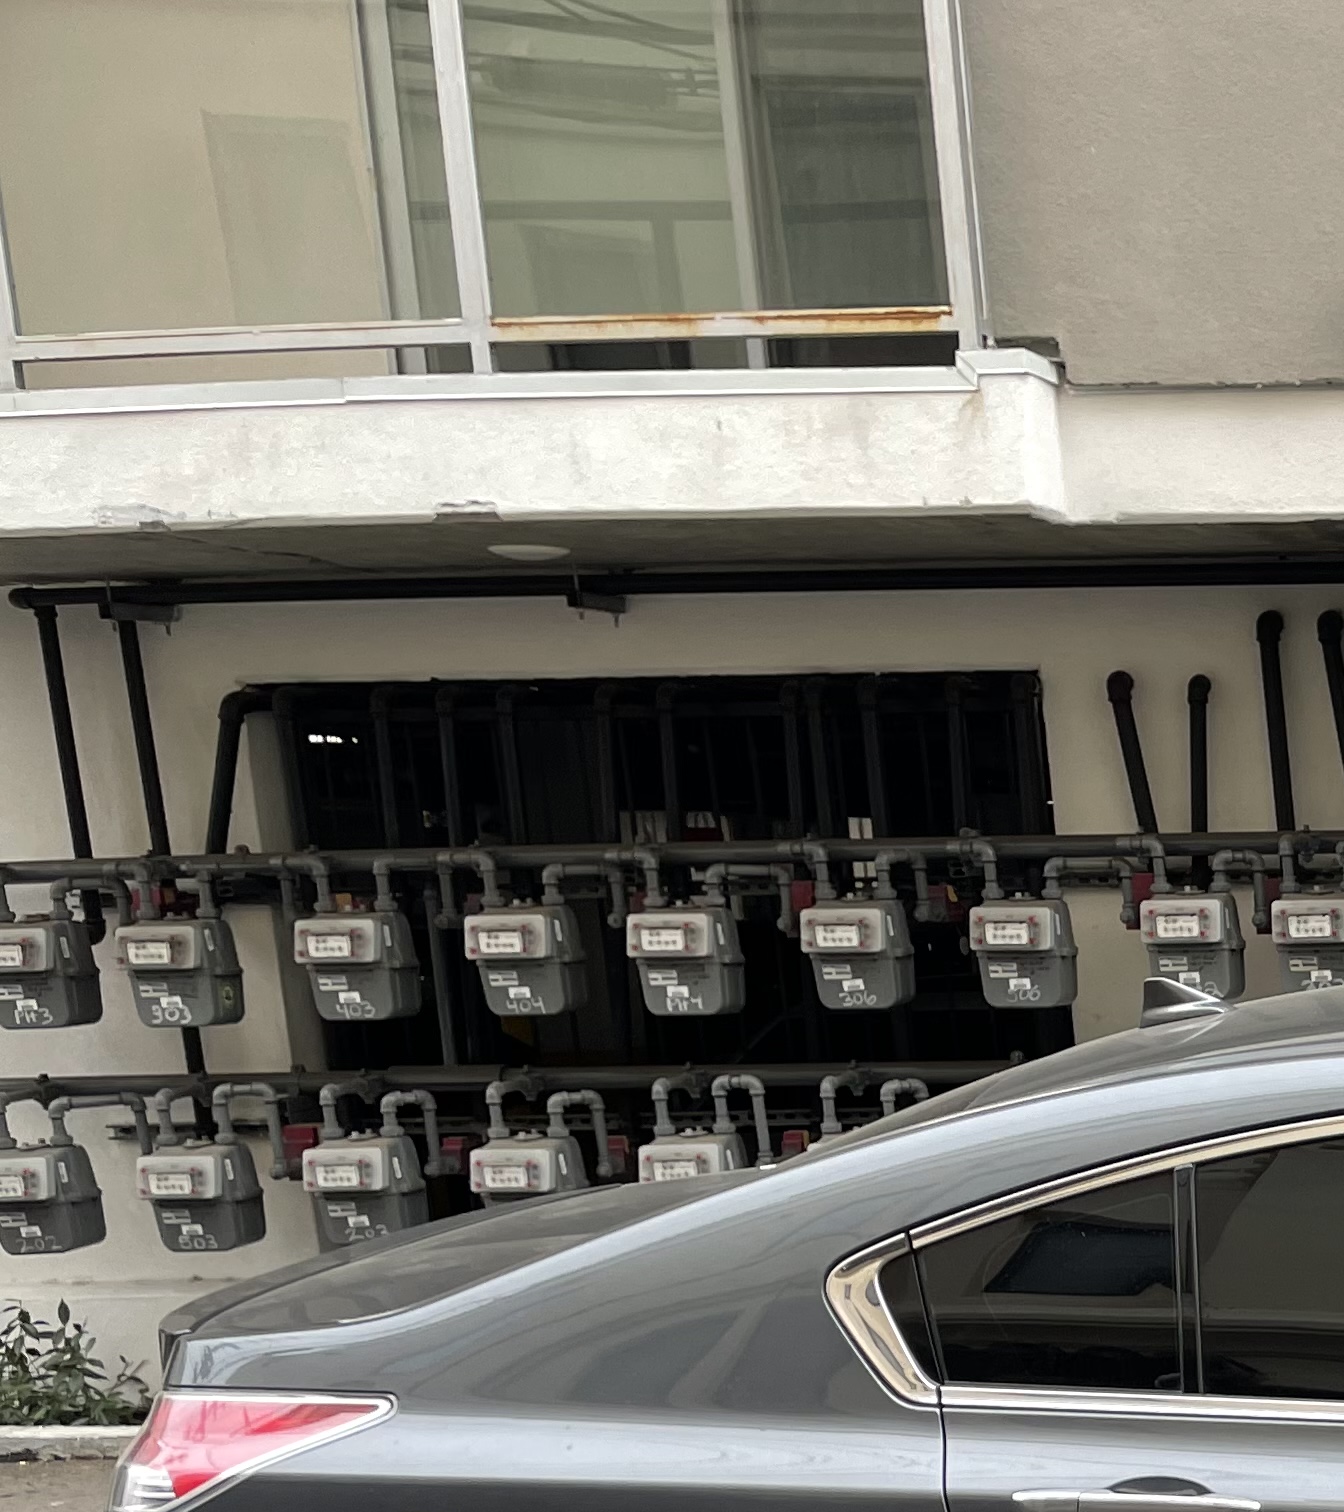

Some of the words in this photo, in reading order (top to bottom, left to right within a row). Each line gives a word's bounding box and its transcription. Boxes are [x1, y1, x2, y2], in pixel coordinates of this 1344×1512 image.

[506, 996, 546, 1014] 404
[839, 990, 877, 1007] 306
[336, 1000, 375, 1019] 403
[16, 1235, 63, 1253] 202
